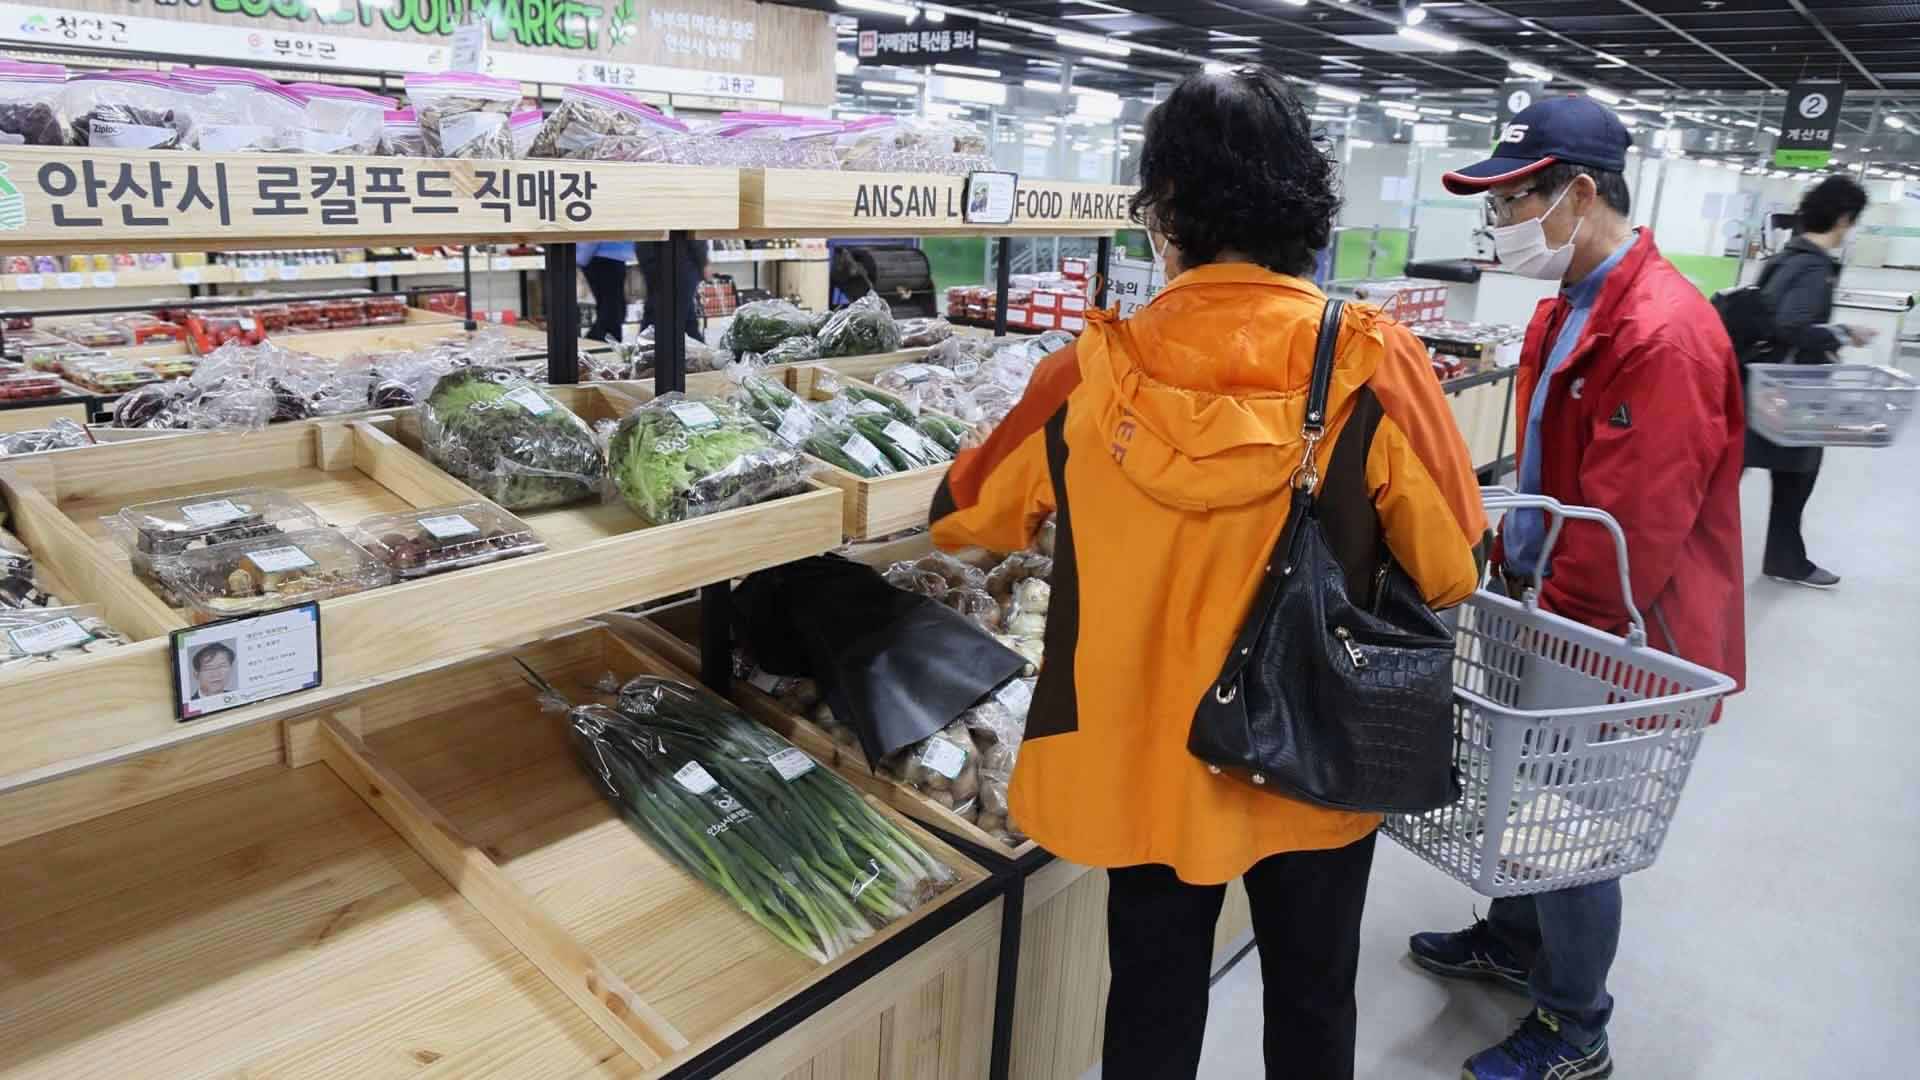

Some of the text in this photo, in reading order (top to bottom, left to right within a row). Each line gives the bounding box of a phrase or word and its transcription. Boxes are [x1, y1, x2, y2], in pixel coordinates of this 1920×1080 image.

[470, 0, 604, 49] MARKET
[952, 30, 975, 49] 코너
[1805, 97, 1820, 114] 2
[1786, 129, 1831, 141] 계산대
[37, 159, 597, 227] 안산시 로컬푸드 직매장
[854, 184, 936, 217] ANSAN
[1015, 189, 1062, 219] FOOD
[1106, 279, 1137, 296] 오늘의
